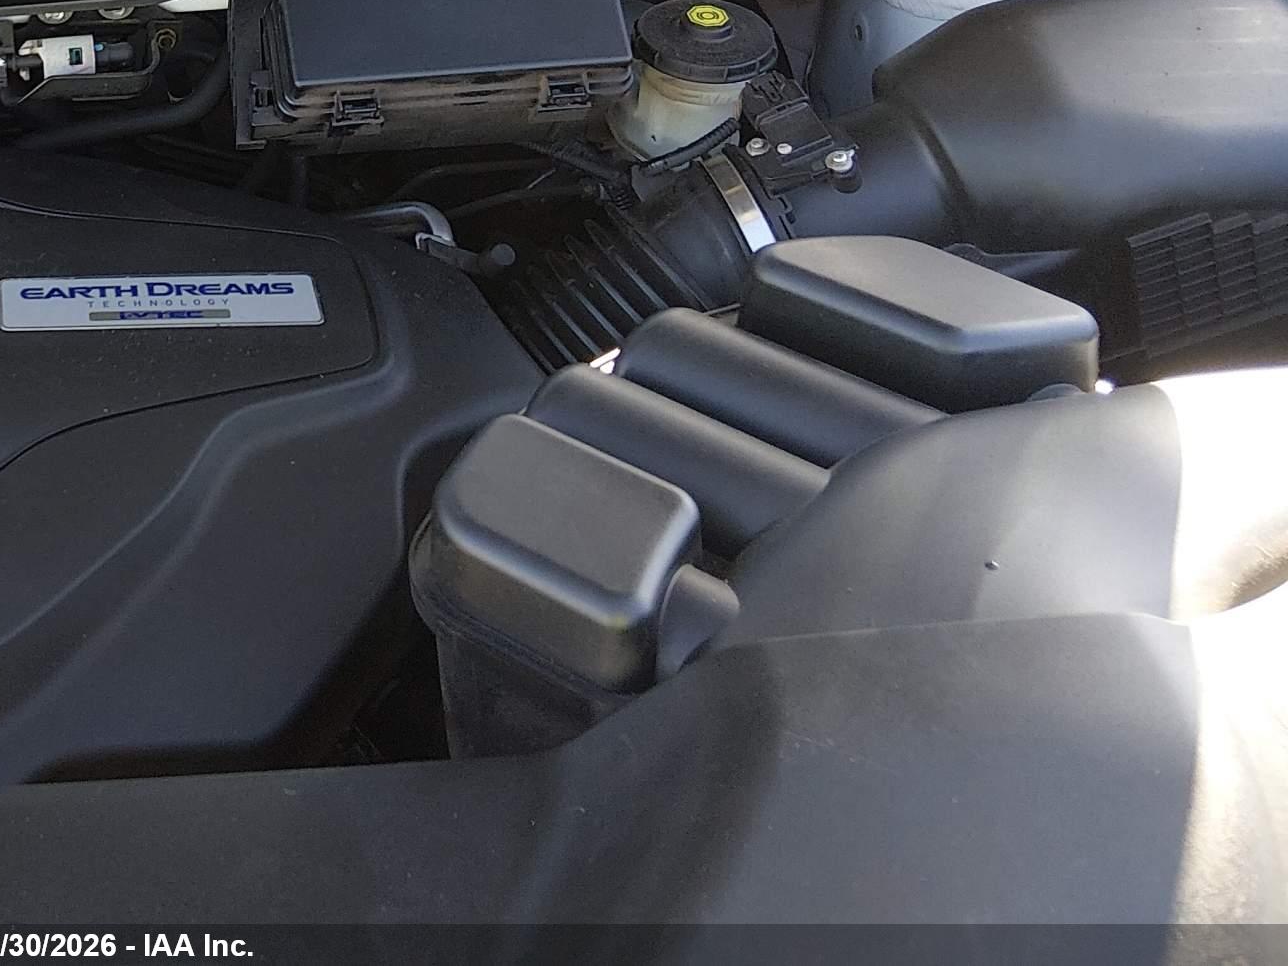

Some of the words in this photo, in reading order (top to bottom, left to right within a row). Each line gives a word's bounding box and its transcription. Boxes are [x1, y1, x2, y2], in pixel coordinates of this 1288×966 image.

[20, 284, 139, 300] EARTH
[145, 281, 295, 297] DREAMS
[88, 298, 230, 309] TECHNOLOGY
